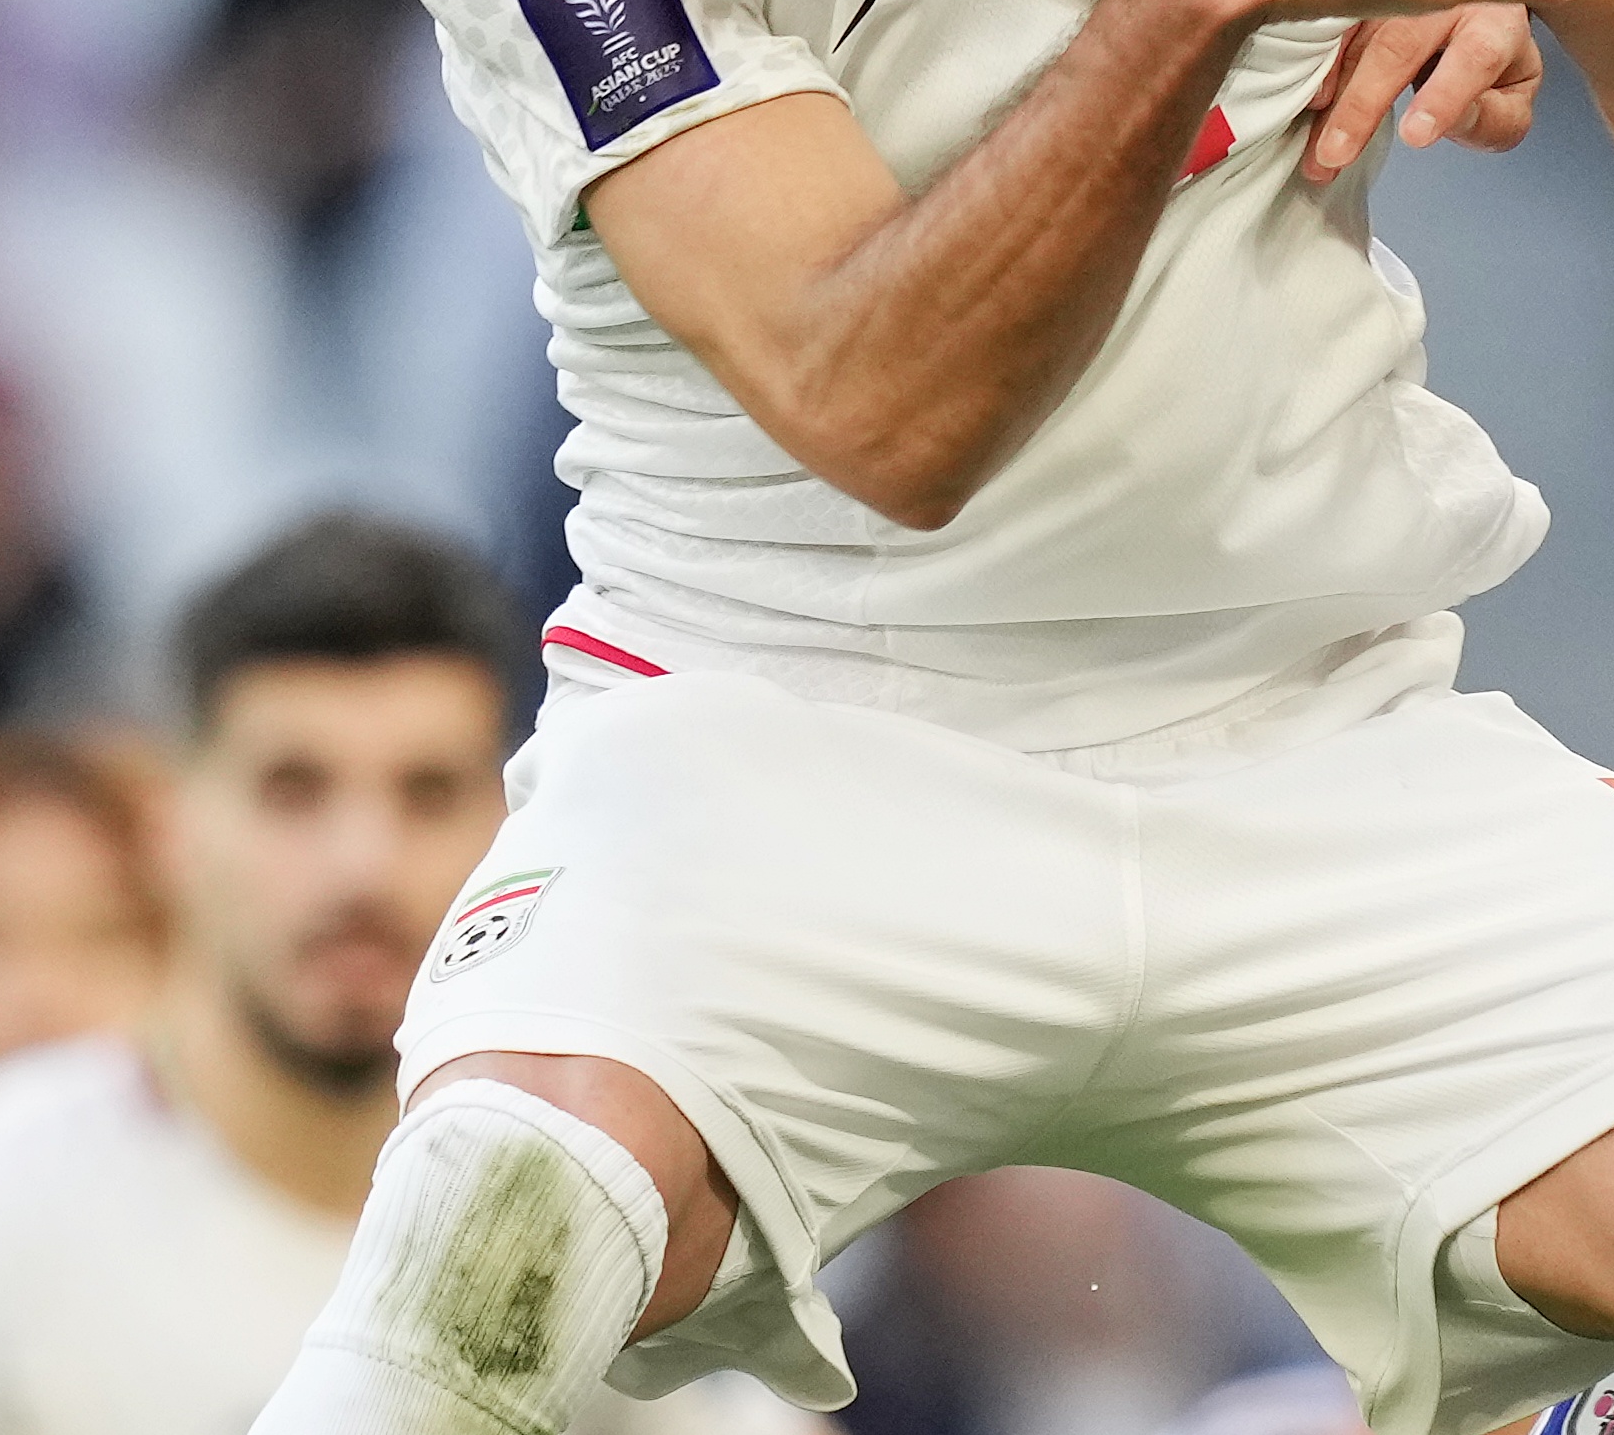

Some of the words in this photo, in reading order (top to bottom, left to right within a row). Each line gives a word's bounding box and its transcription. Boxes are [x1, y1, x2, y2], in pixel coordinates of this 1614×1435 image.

[591, 60, 642, 101] ASIAN
[640, 42, 681, 70] CUP
[611, 46, 639, 70] AFC
